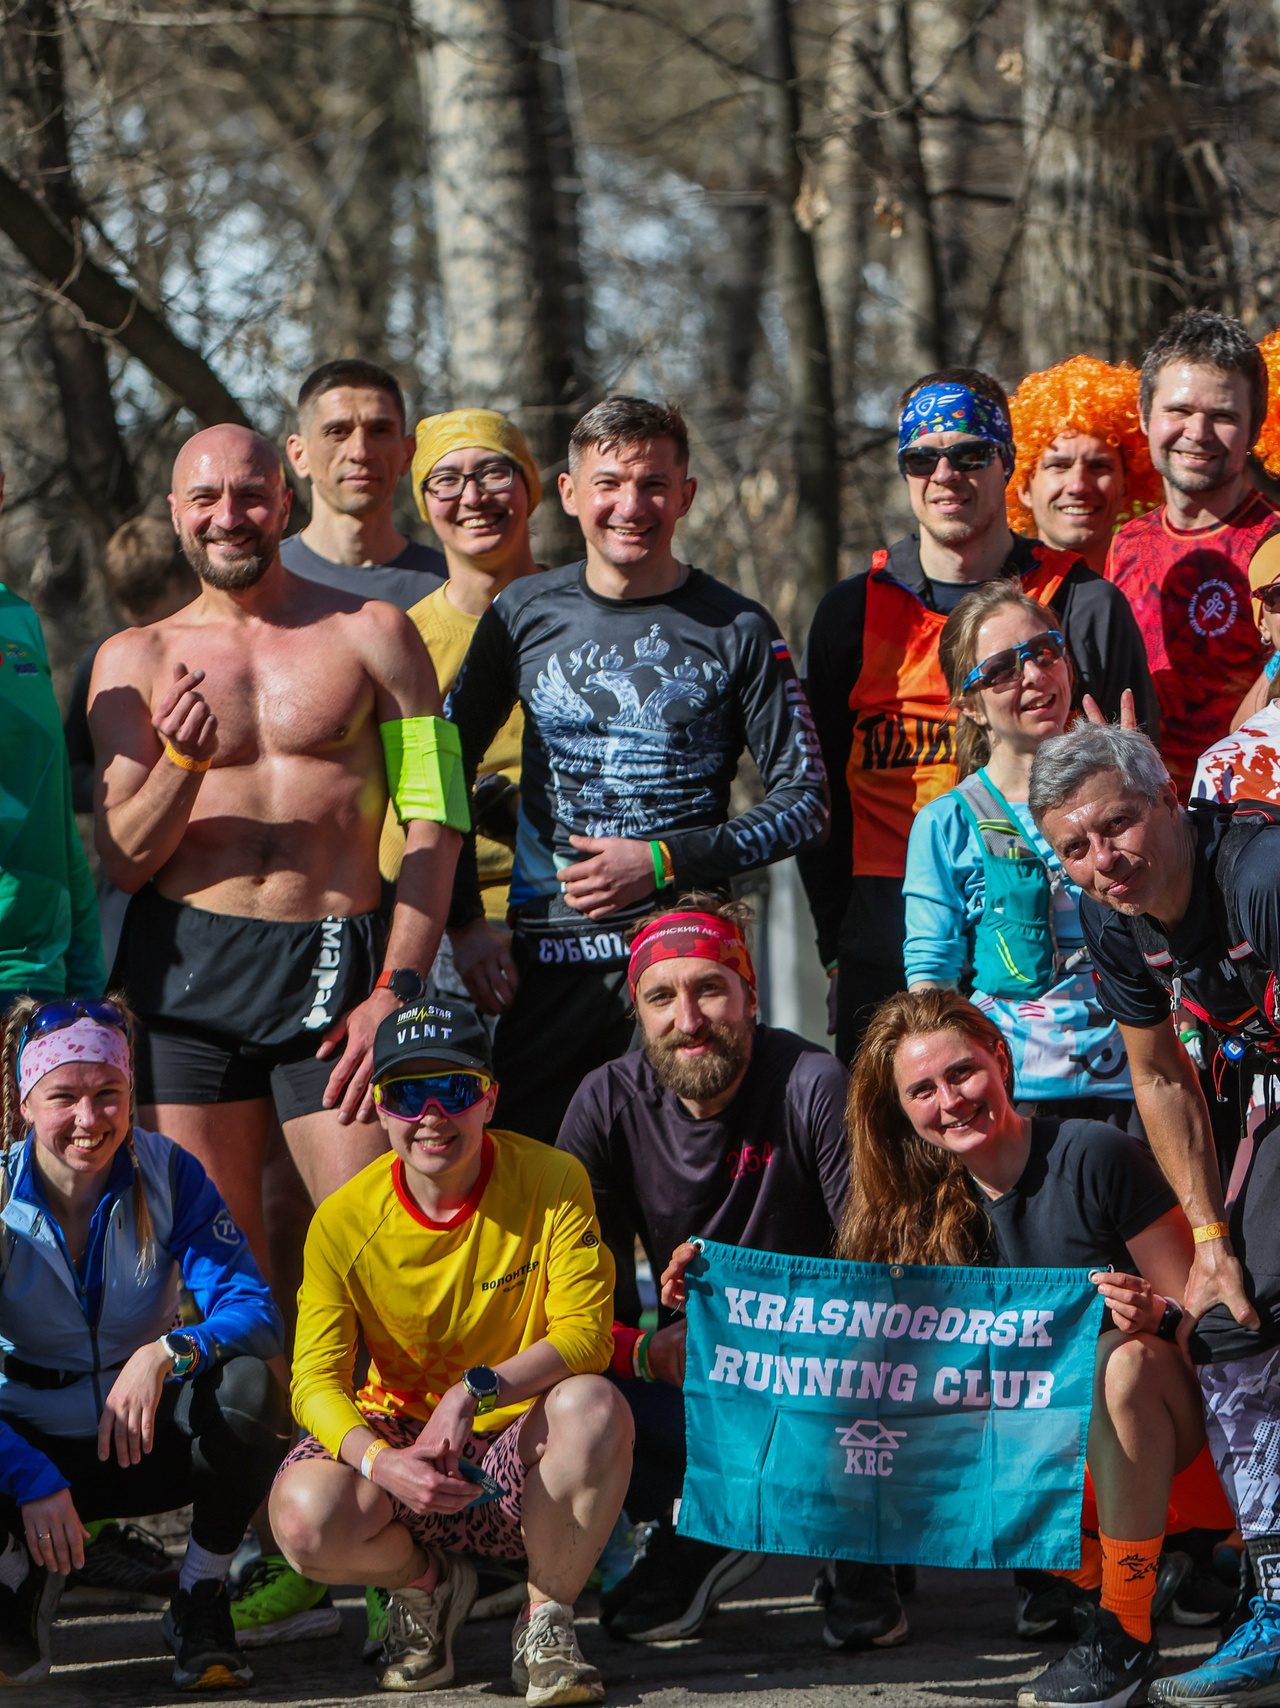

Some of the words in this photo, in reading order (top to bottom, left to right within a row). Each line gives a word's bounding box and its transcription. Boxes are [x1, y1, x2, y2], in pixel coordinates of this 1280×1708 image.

[539, 932, 632, 964] СУББОТ
[397, 1007, 419, 1023] IRON
[428, 1005, 452, 1019] STAR
[724, 1287, 1054, 1347] KRASNOGORSK
[708, 1344, 918, 1401] RUNNING
[933, 1366, 1055, 1408] CLUB
[844, 1448, 893, 1476] KRC
